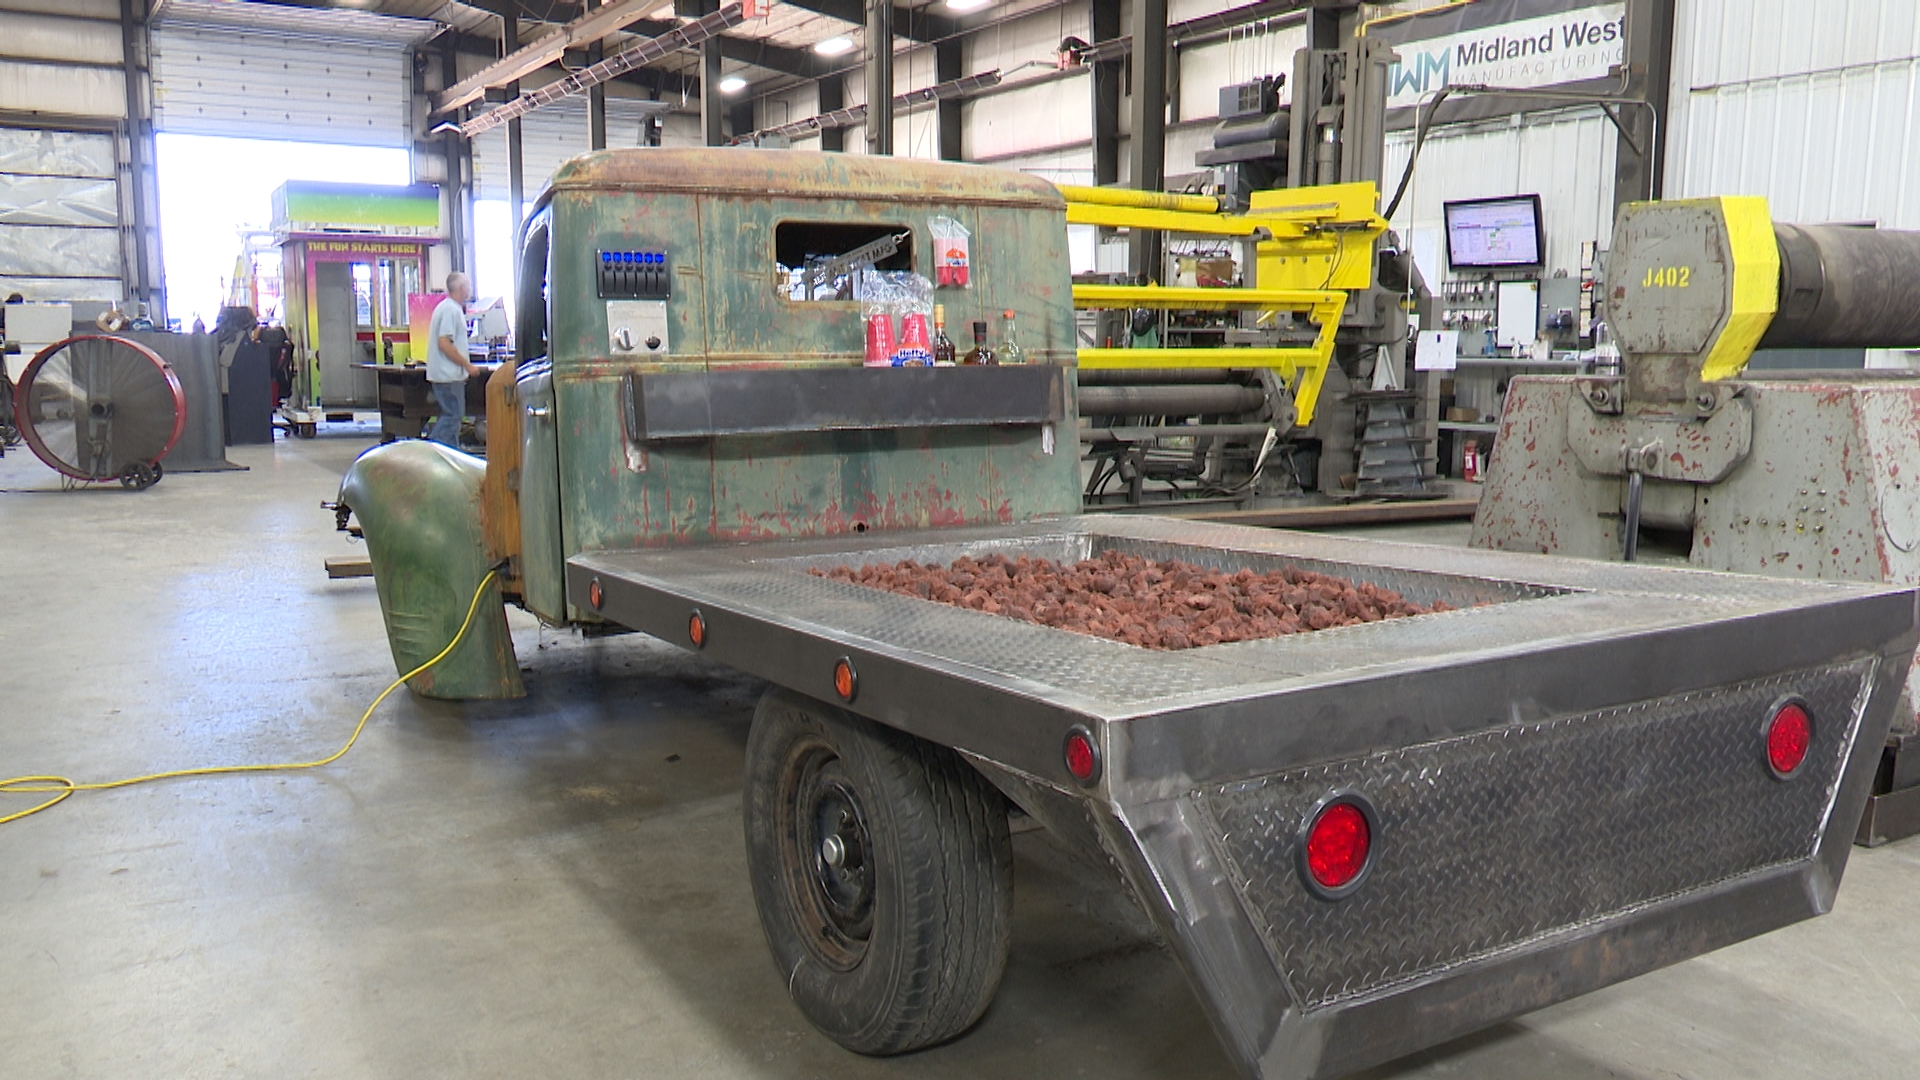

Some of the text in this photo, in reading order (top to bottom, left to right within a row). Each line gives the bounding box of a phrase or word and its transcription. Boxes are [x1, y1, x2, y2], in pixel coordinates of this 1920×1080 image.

[1456, 16, 1624, 67] Midland West
[1388, 47, 1450, 96] WM
[308, 242, 327, 251] THE
[330, 242, 349, 252] FUN
[351, 242, 388, 253] STARTS
[391, 244, 416, 254] HERE
[1642, 266, 1690, 288] J402
